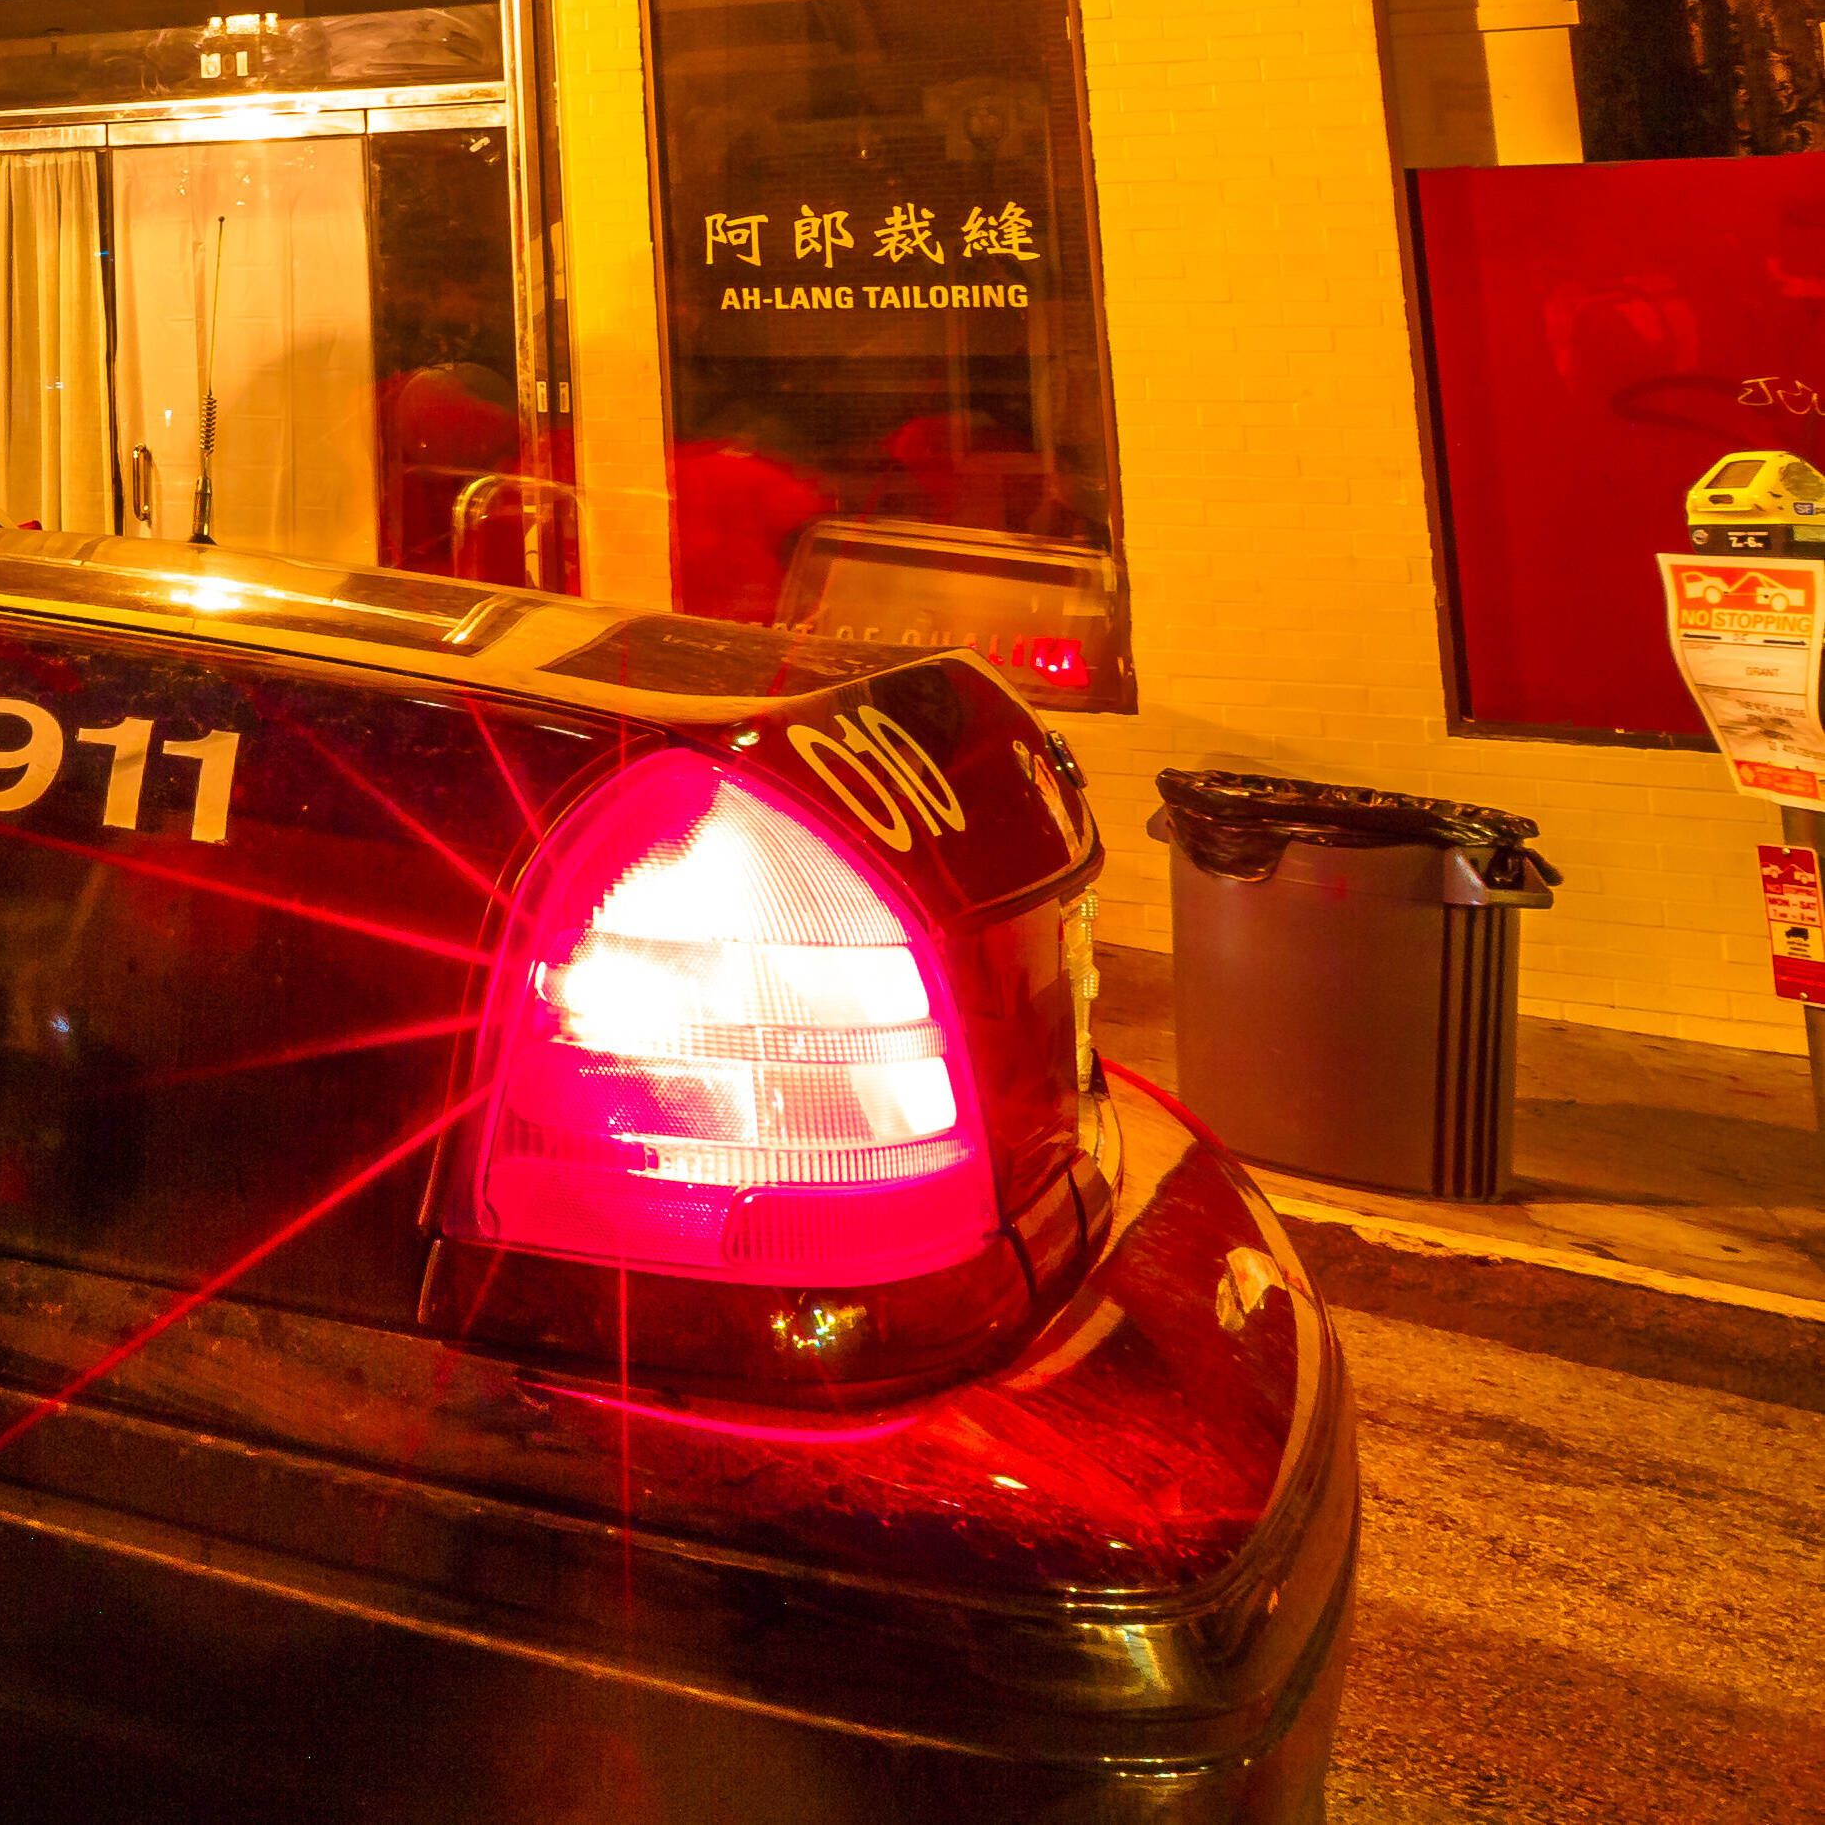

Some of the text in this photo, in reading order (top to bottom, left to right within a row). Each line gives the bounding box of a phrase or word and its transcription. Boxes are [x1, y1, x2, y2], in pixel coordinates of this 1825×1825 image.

[704, 201, 1041, 268] 阿郎裁縫
[720, 284, 1029, 310] AH-LANG TAILORING
[1681, 608, 1812, 633] NO STOPPING
[786, 704, 966, 853] 010
